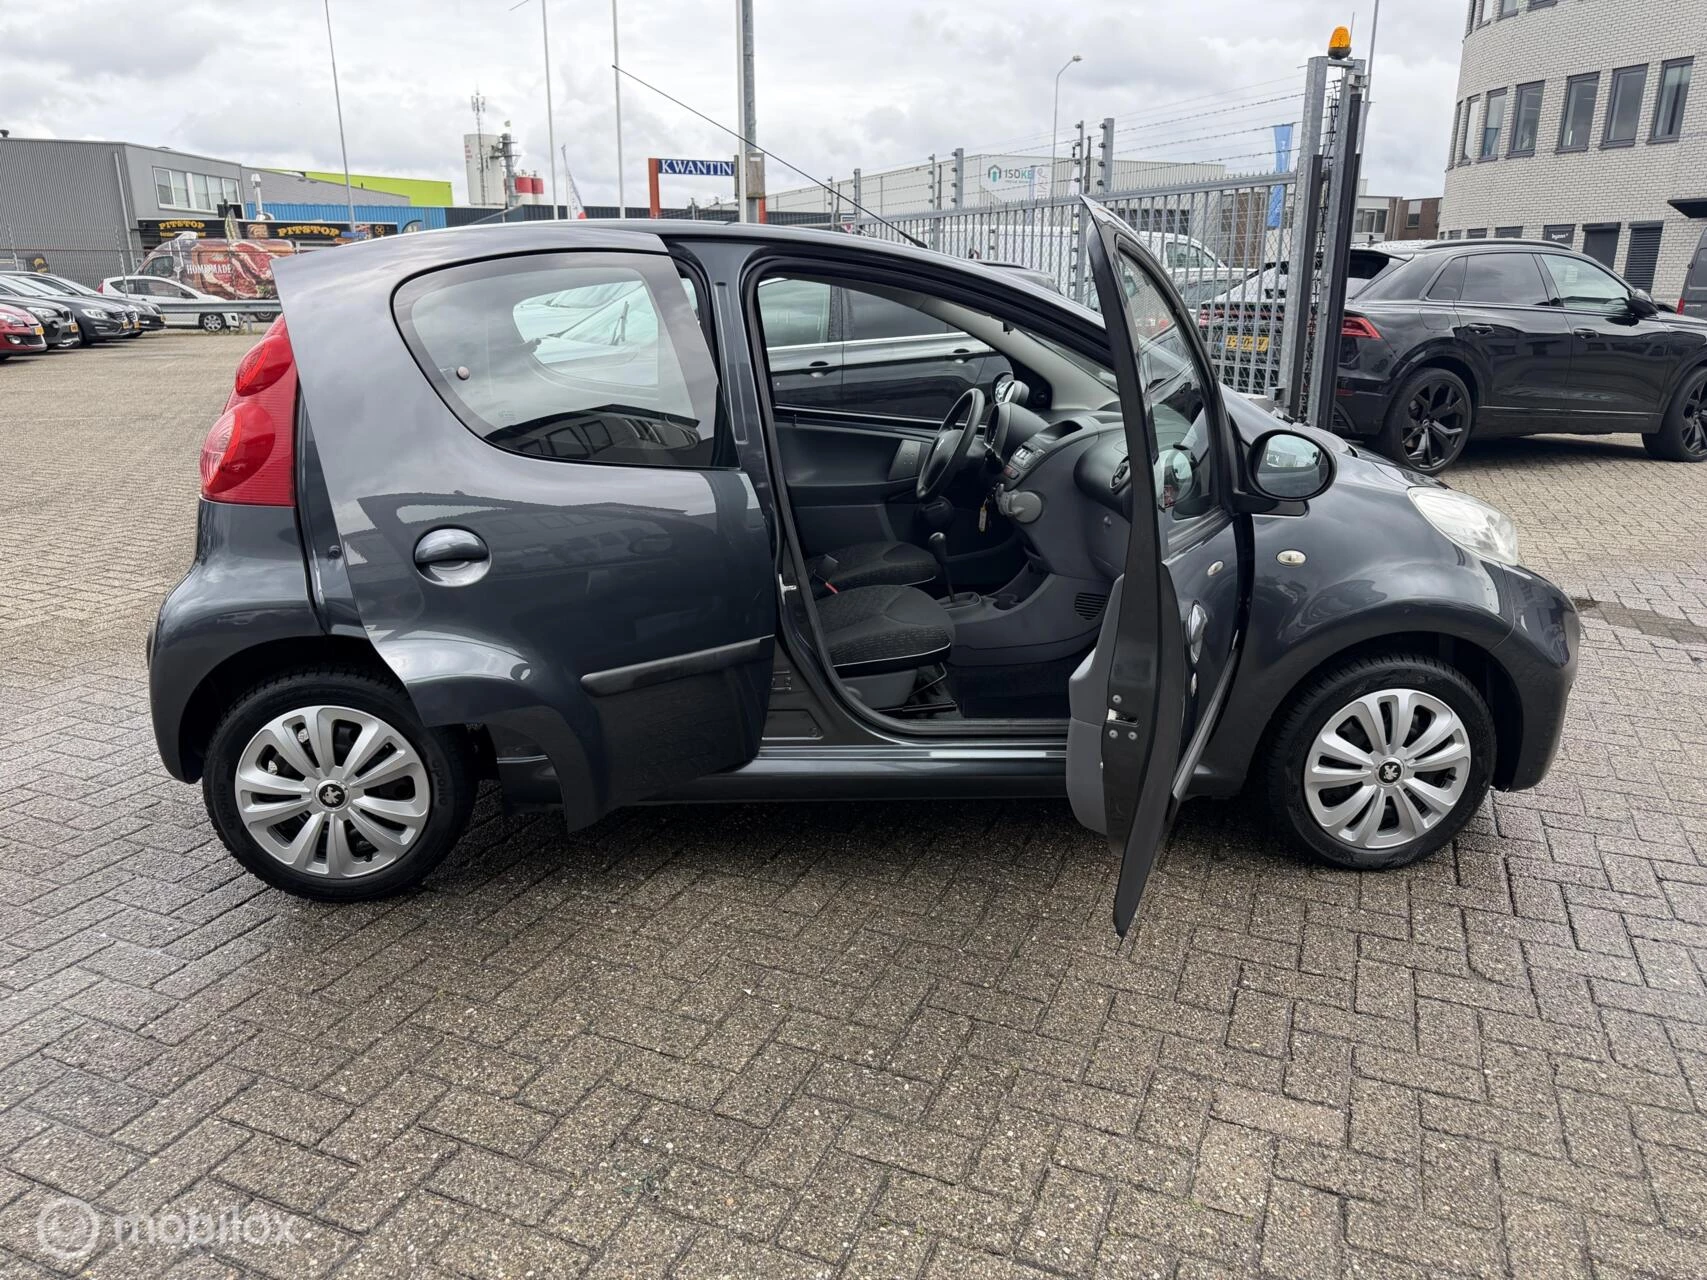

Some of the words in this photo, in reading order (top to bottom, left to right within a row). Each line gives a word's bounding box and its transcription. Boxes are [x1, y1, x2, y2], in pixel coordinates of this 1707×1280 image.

[661, 159, 732, 176] KWANTIN
[1004, 168, 1034, 179] ISOKE
[158, 220, 205, 230] PITSTOP
[277, 225, 340, 237] PITSTOP
